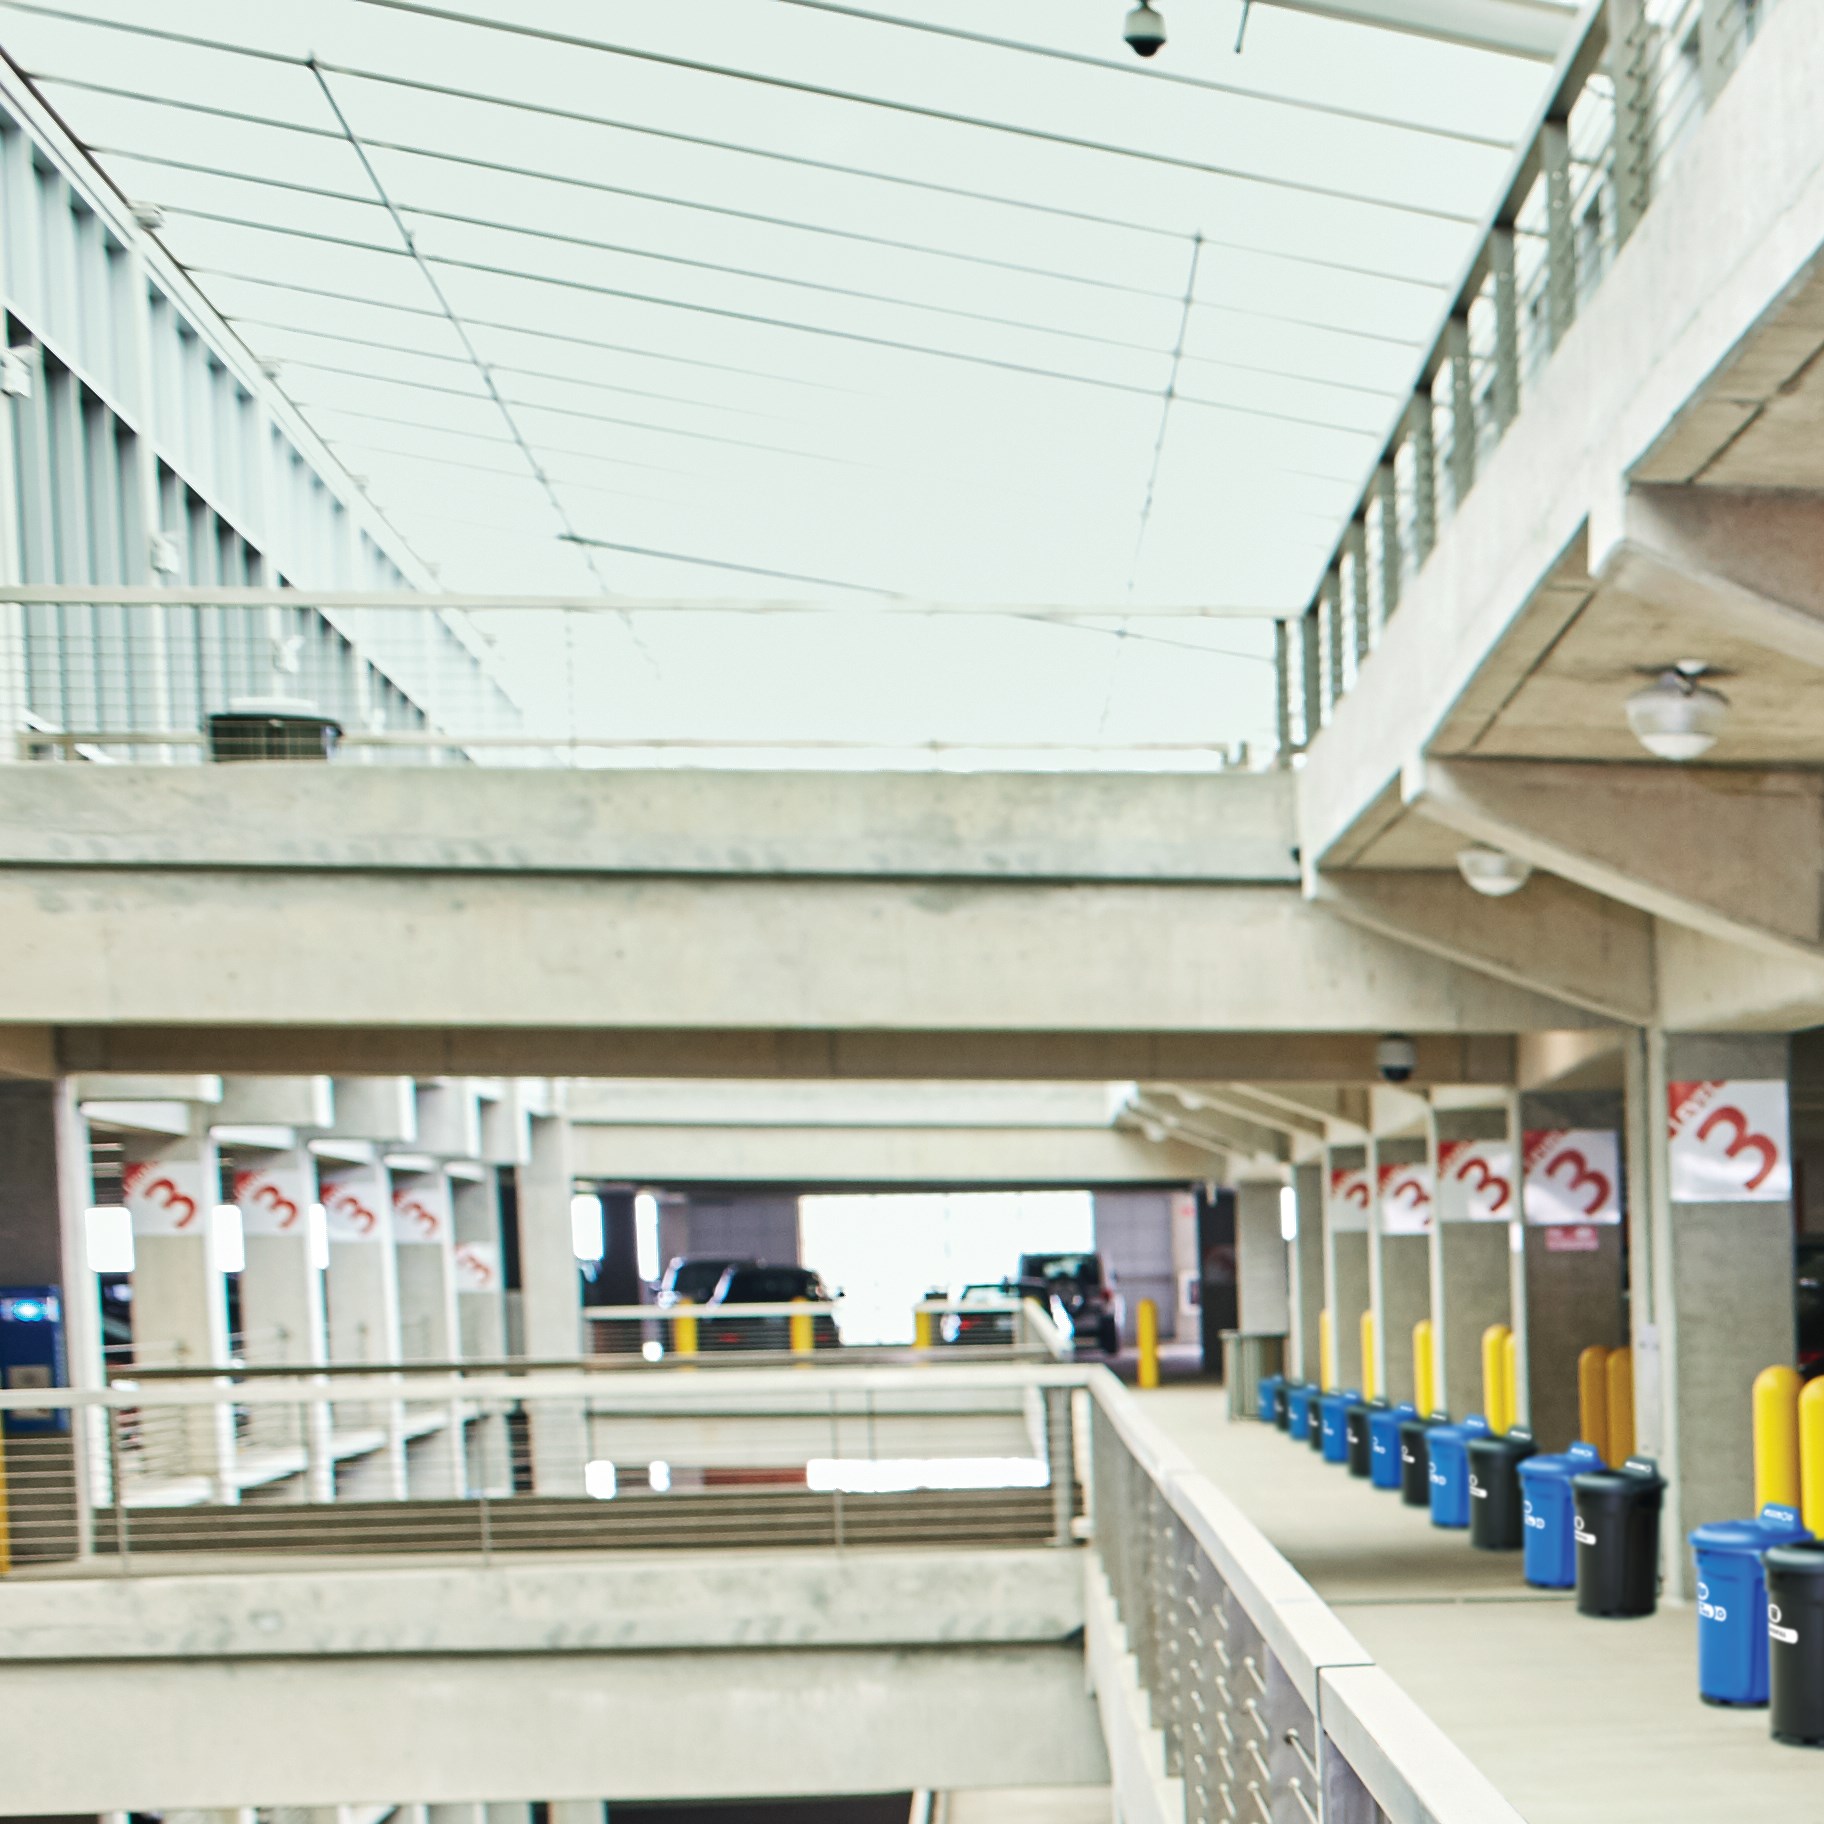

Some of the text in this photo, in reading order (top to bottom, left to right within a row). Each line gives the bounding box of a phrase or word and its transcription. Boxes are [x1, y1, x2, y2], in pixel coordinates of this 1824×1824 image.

[1697, 1105, 1778, 1191] 3
[145, 1178, 196, 1228] 3
[253, 1185, 298, 1228] 3
[1456, 1157, 1511, 1212] 3
[1545, 1148, 1610, 1215] 3
[336, 1197, 376, 1236] 3
